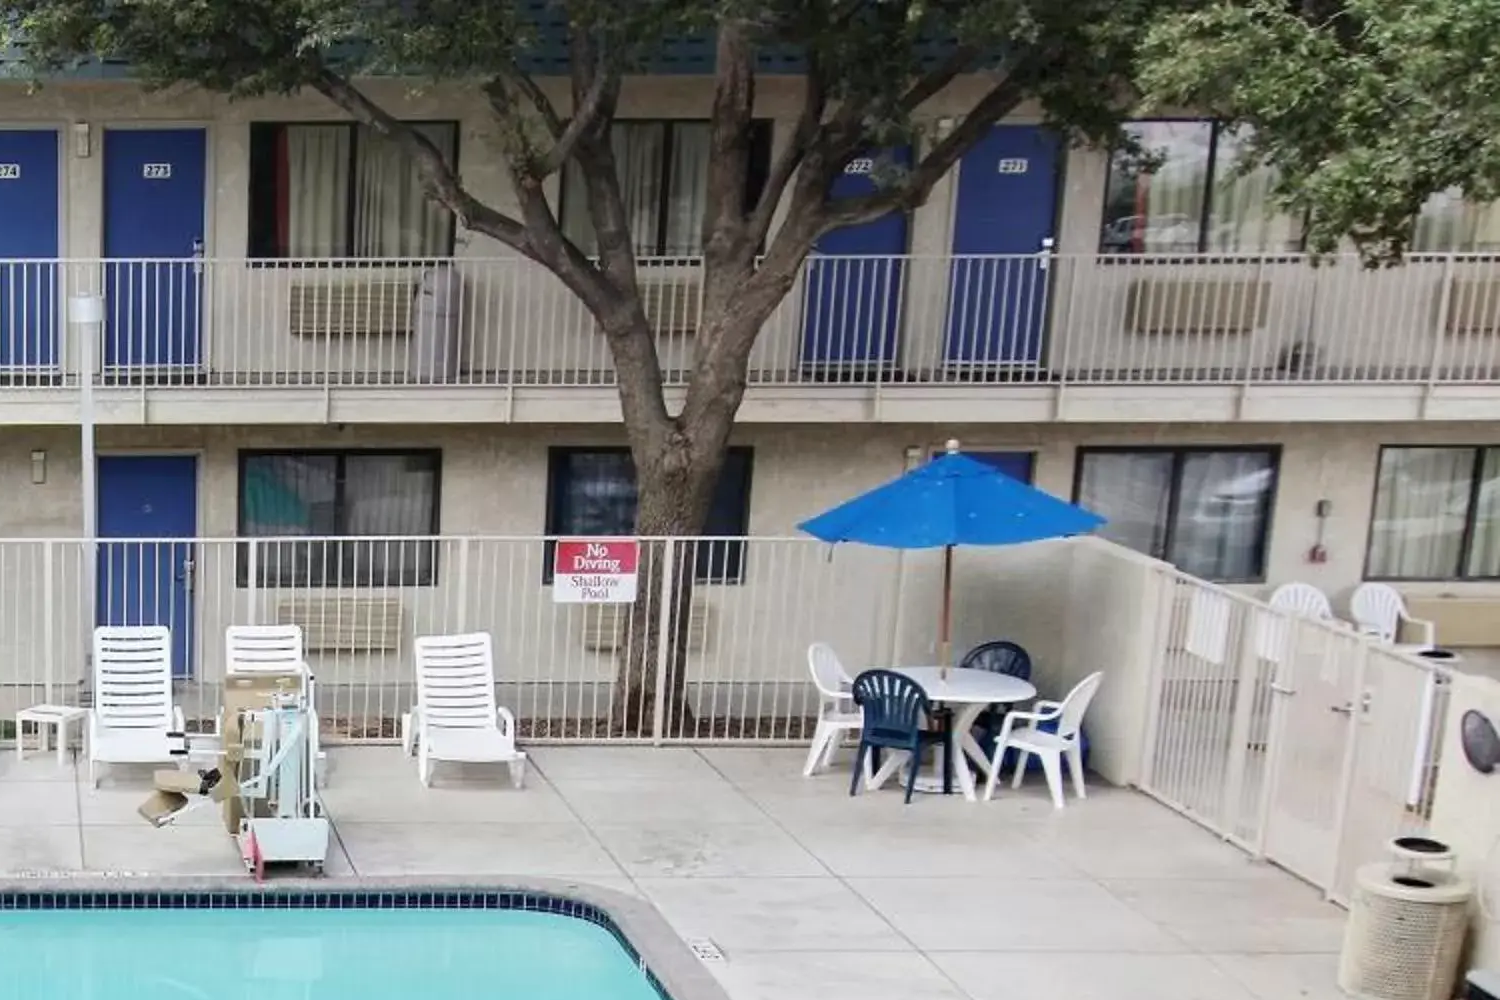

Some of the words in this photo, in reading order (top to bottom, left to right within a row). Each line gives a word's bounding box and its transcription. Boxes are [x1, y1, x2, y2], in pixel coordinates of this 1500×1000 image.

[587, 543, 609, 557] No
[574, 556, 621, 573] Diving
[571, 575, 620, 587] Shallow
[581, 588, 610, 599] Pool
